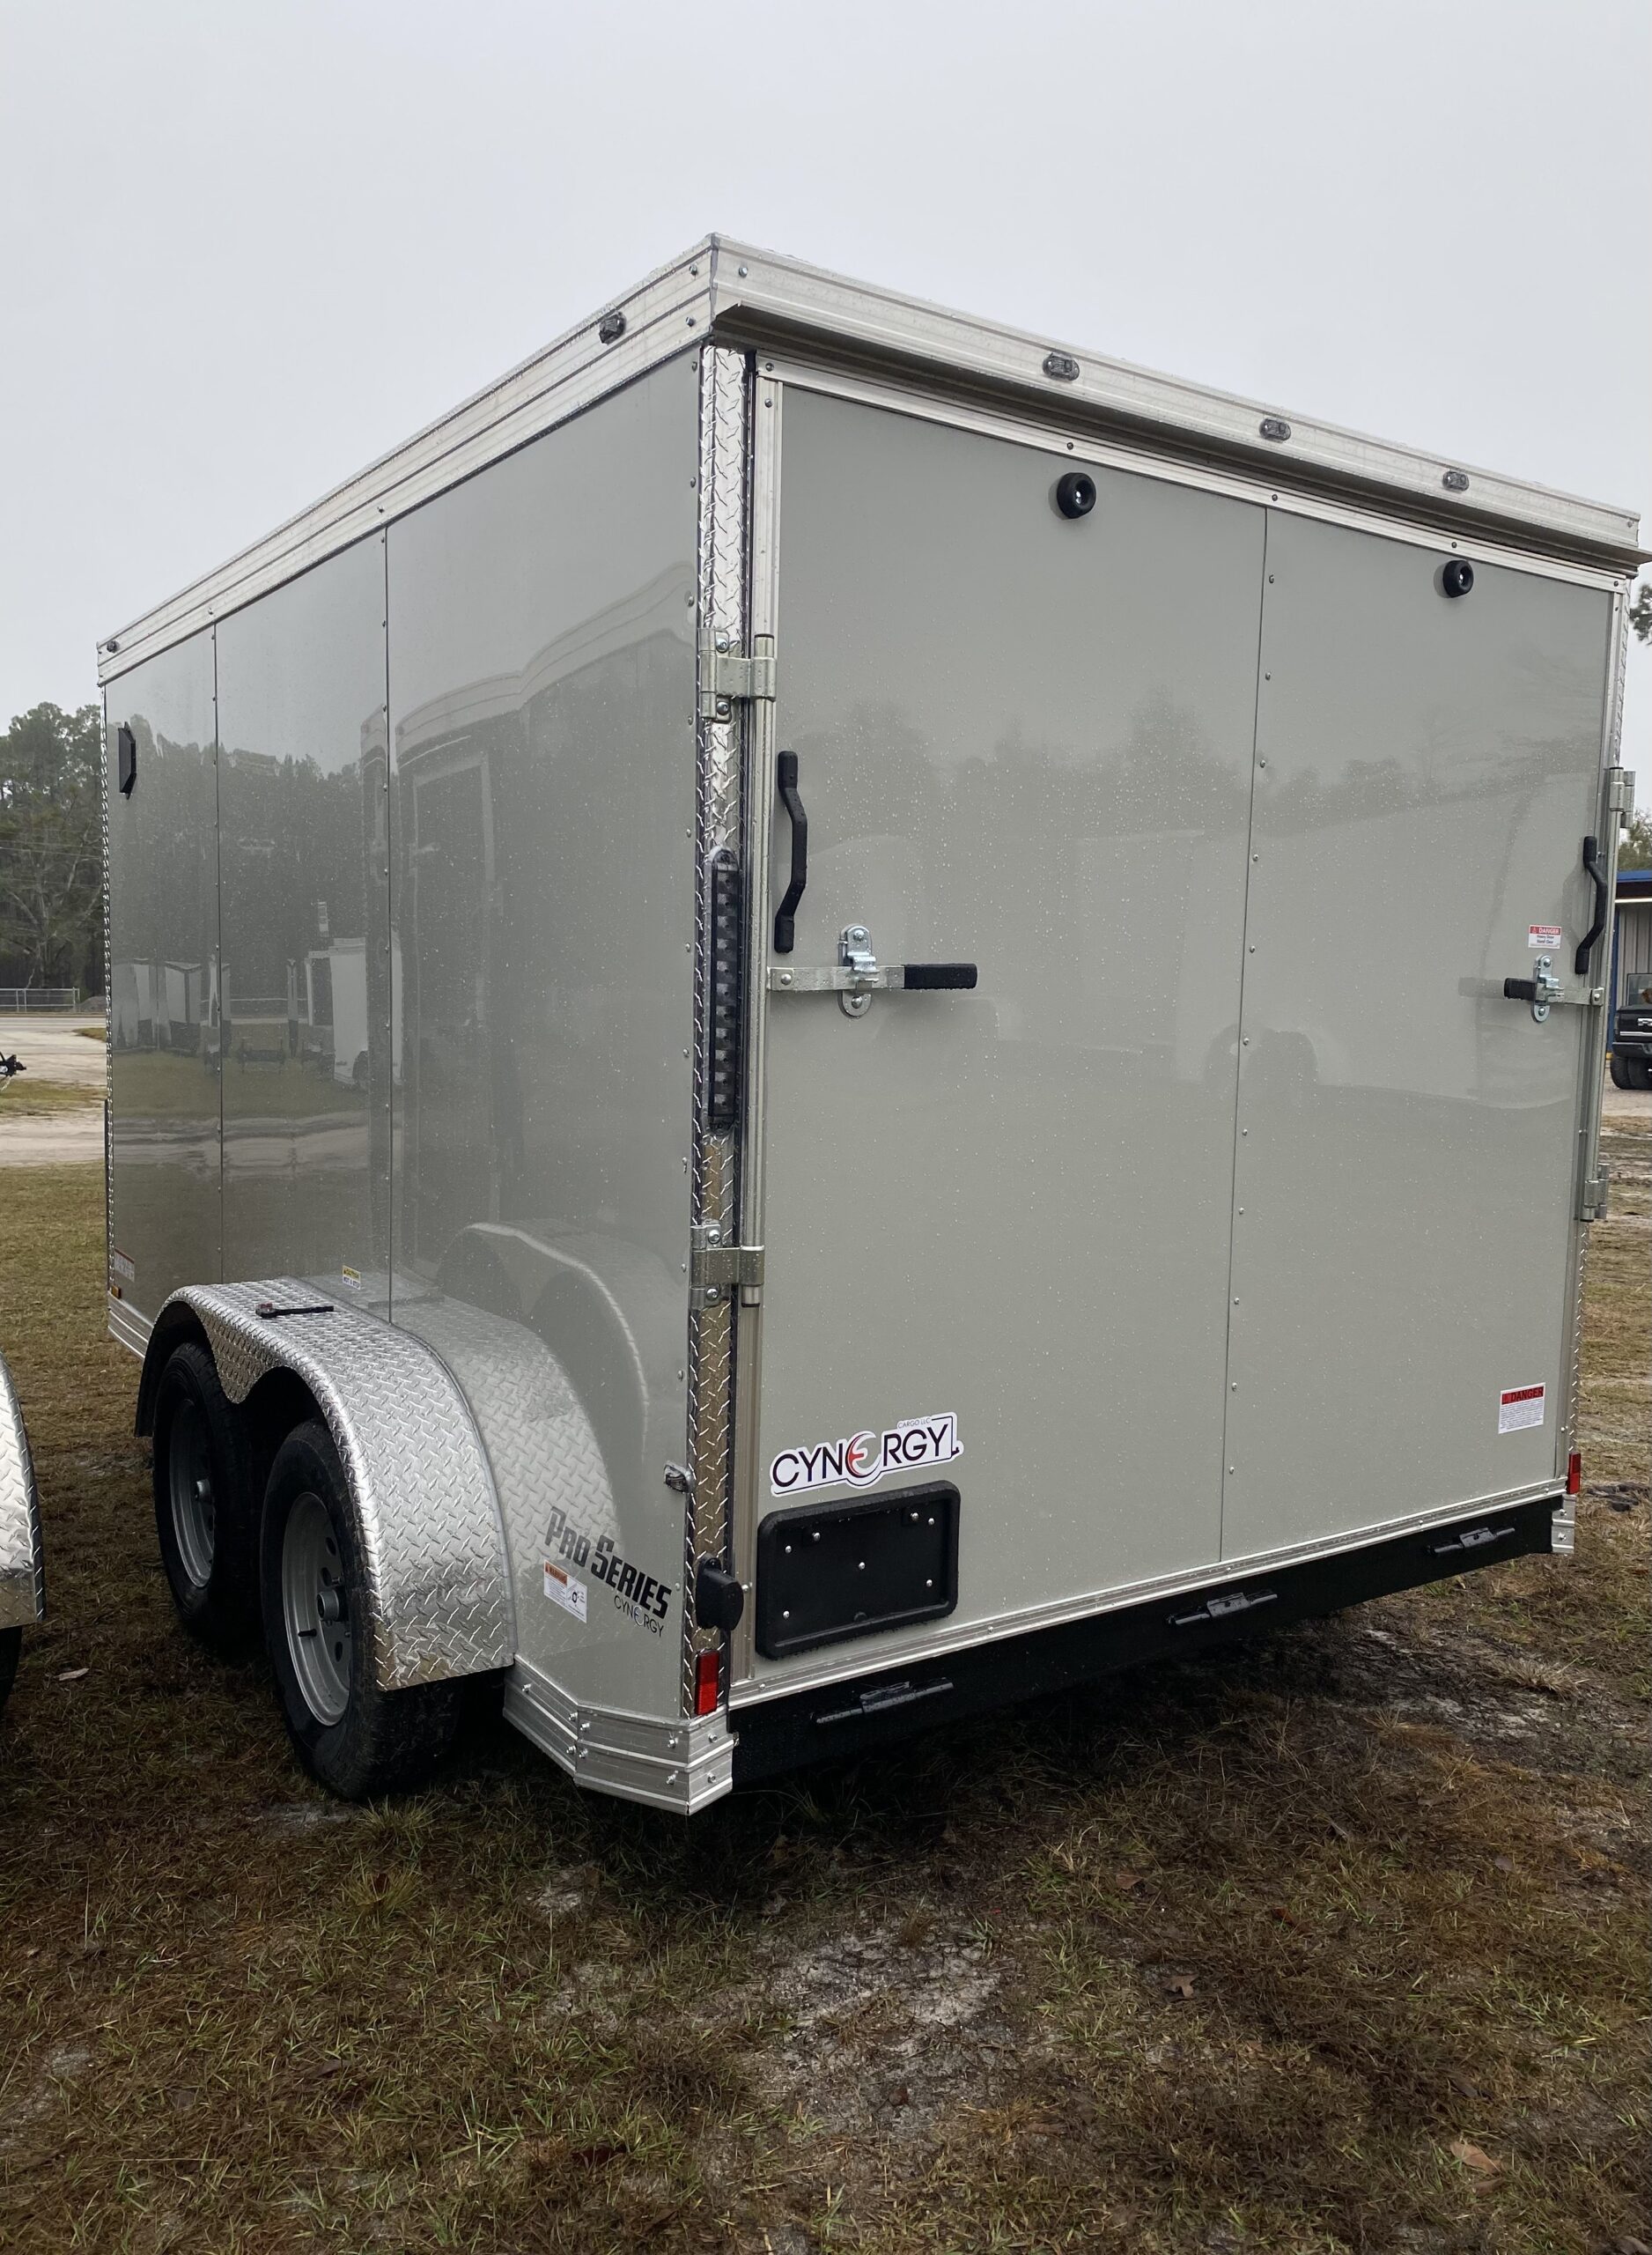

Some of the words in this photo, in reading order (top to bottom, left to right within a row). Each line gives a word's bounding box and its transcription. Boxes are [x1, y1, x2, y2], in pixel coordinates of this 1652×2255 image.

[1511, 1387, 1544, 1402] DANGER
[898, 1419, 920, 1429] CARGO
[772, 1423, 948, 1487] CYNERGY
[614, 1595, 664, 1638] CYNERGY
